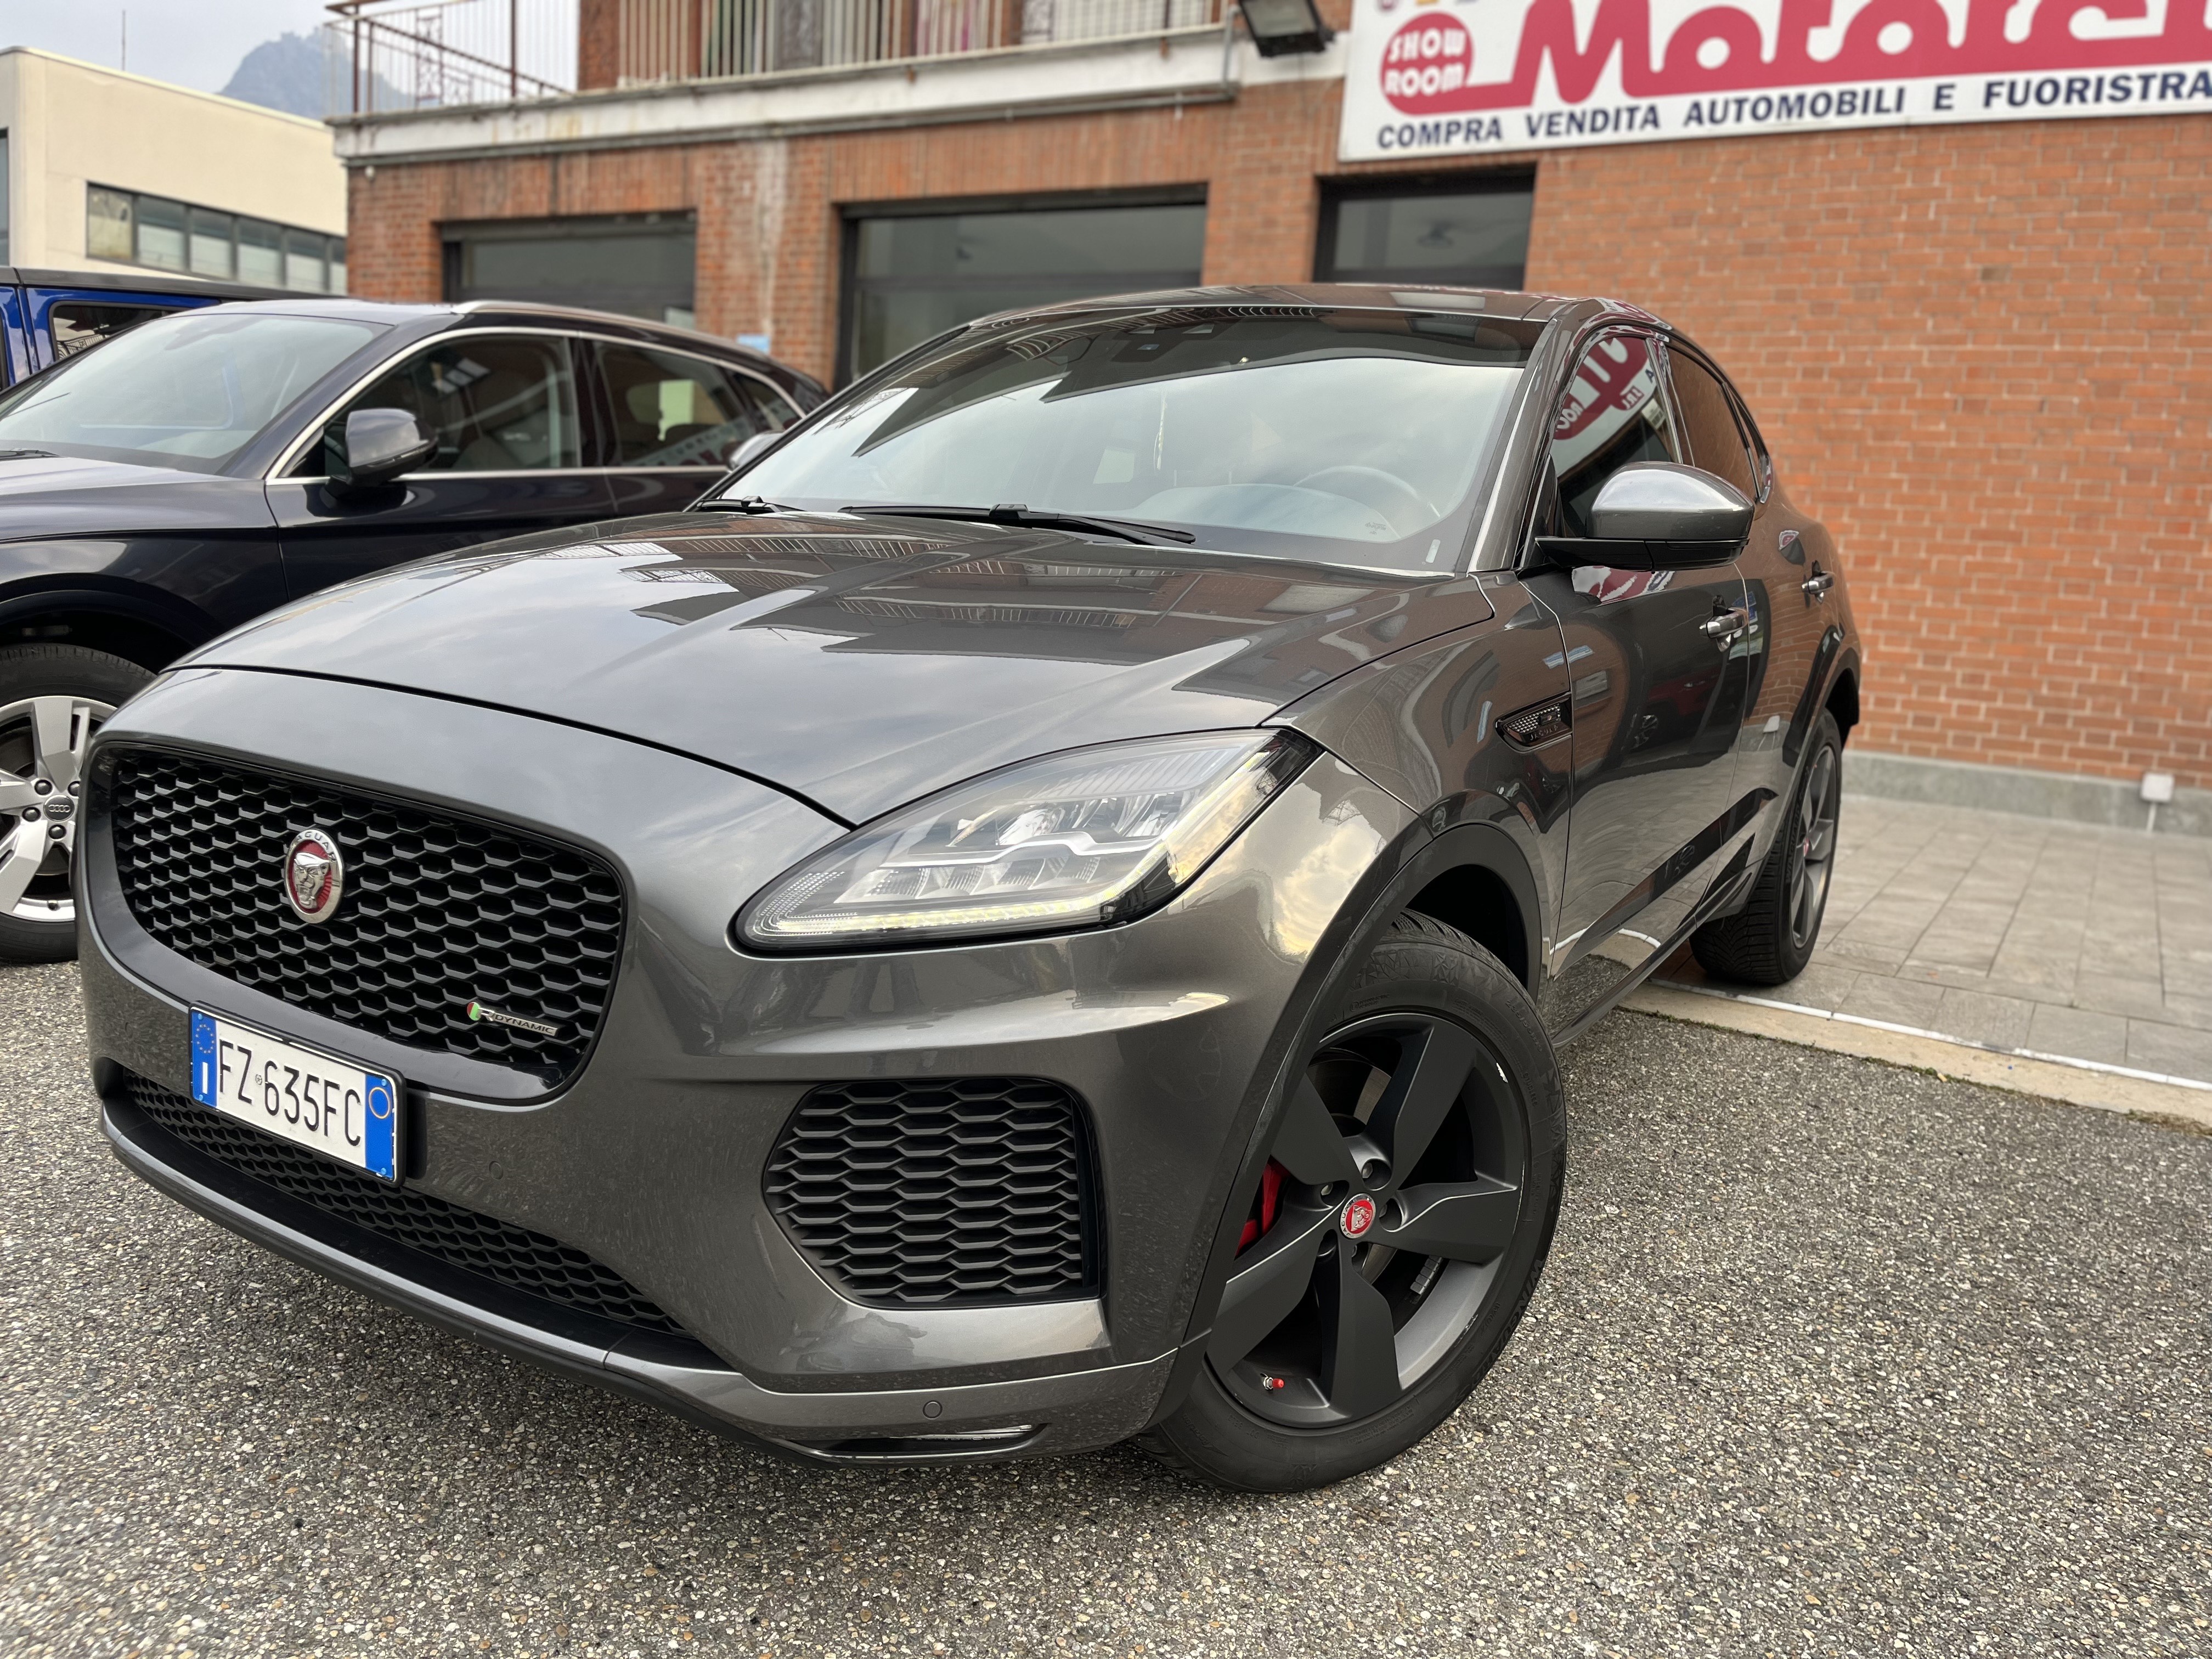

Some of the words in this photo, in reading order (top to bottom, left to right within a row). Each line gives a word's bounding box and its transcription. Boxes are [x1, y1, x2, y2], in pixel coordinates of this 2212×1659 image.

[1387, 27, 1468, 63] SHOW
[1384, 62, 1466, 98] ROOM
[1377, 115, 1503, 150] COMPRA
[1525, 104, 1661, 138] VENDITA
[1683, 86, 1906, 128] AUTOMOBILI
[1932, 83, 1957, 111] E
[1983, 69, 2212, 109] FUORISTRA
[293, 831, 337, 861] AGUAR
[494, 1013, 555, 1035] DYNAMIC
[219, 1038, 253, 1105] FZ
[263, 1059, 362, 1147] 635FC
[1341, 1199, 1355, 1235] JAGUAR
